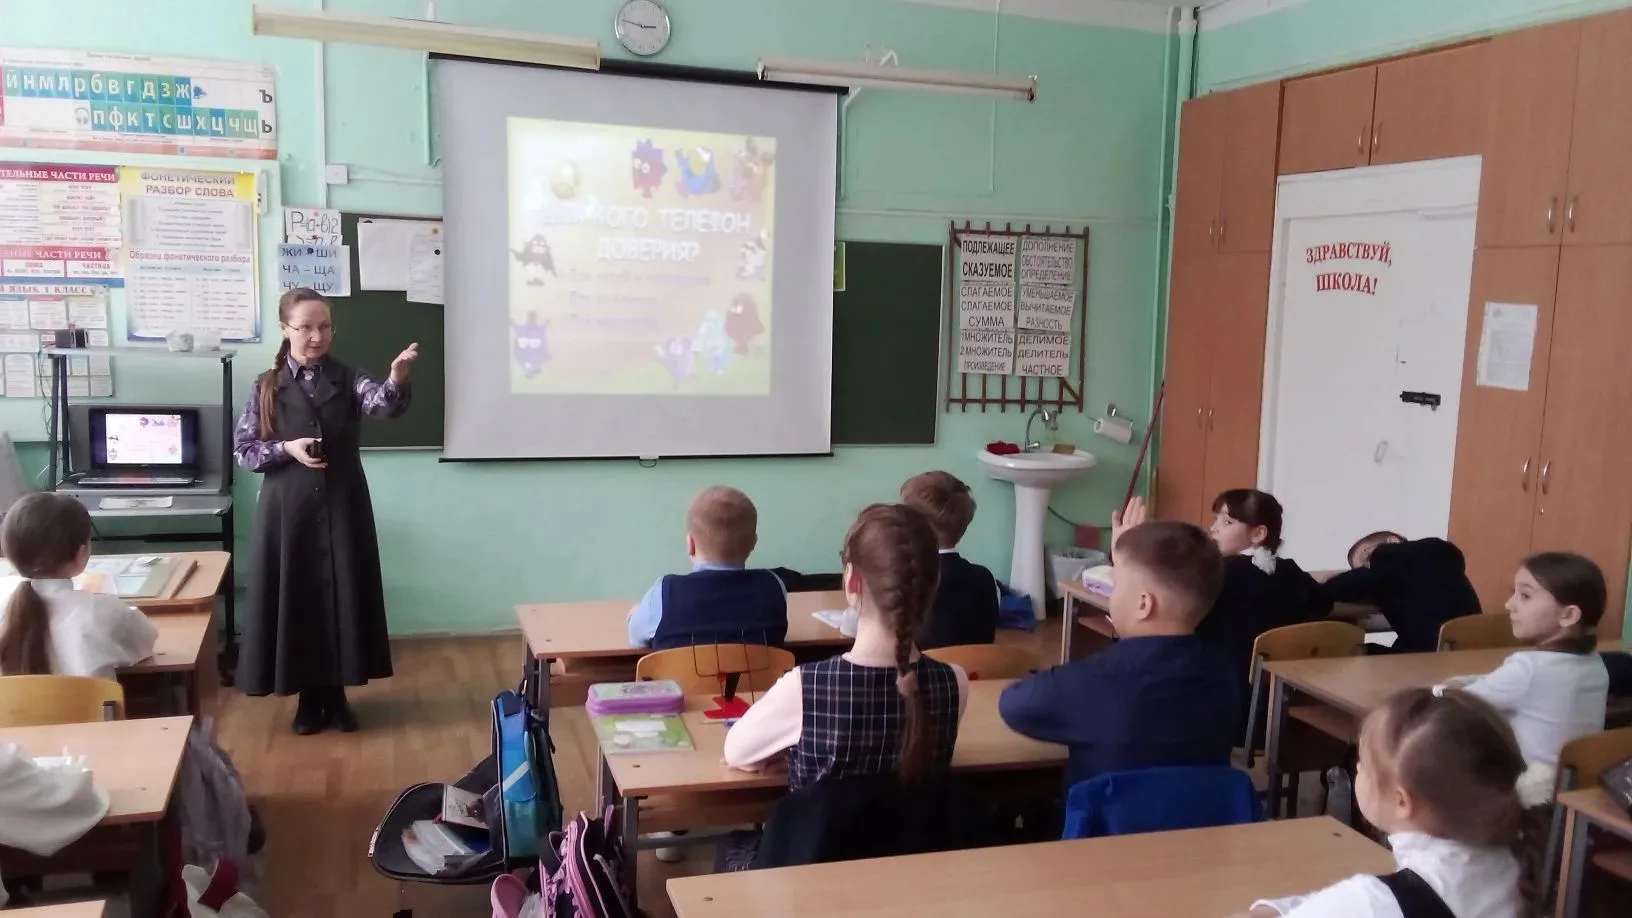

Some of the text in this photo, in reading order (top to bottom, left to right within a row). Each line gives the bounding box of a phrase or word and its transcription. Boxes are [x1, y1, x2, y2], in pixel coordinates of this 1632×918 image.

[50, 171, 87, 180] ЧАСТИ
[88, 172, 115, 182] РЕЧИ
[140, 171, 236, 185] ФОНЕТИЧЕСКИЙ
[146, 185, 234, 198] РАЗБОР СЛОВА
[596, 236, 701, 263] ДОВЕРИЯ?
[962, 240, 1015, 255] ПОДЛЕЖАЩЕЕ
[1022, 240, 1074, 252] ДОПОЛНЕНИЕ
[35, 250, 71, 259] ЧАСТИ
[74, 251, 101, 259] РЕЧИ
[281, 248, 337, 258] ЖИ ШИ
[1306, 240, 1392, 268] ЗДРАВСТВУЙ,
[1021, 256, 1072, 269] ОБСТОЯТЕЛЬСТВО
[282, 264, 300, 274] ЧА
[314, 265, 335, 276] ЩА
[962, 262, 1012, 278] СКАЗУЕМОЕ
[1021, 269, 1071, 281] ОПРЕДЕЛЕНИЕ
[9, 285, 39, 293] ЯЗЫК
[54, 286, 88, 294] КЛАСС
[314, 282, 335, 293] ЩУ
[1316, 272, 1378, 296] ШКОЛА!
[961, 286, 1012, 297] СЛАГАЕМОЕ
[1022, 287, 1073, 302] УМЕНЬШАЕМОЕ
[961, 301, 1012, 311] СЛАГАЕМОЕ
[1020, 302, 1071, 315] ВЫЧИТАЕМОЕ
[968, 316, 1004, 327] СУММА
[1026, 317, 1062, 329] РАЗНОСТЬ
[1018, 335, 1069, 345] ДЕЛИМОЕ
[1017, 349, 1069, 358] ДЕЛИТЕЛЬ
[964, 360, 1006, 371] ПРОИЗВЕДЕНИЕ
[1022, 364, 1062, 376] ЧАСТНОЕ
